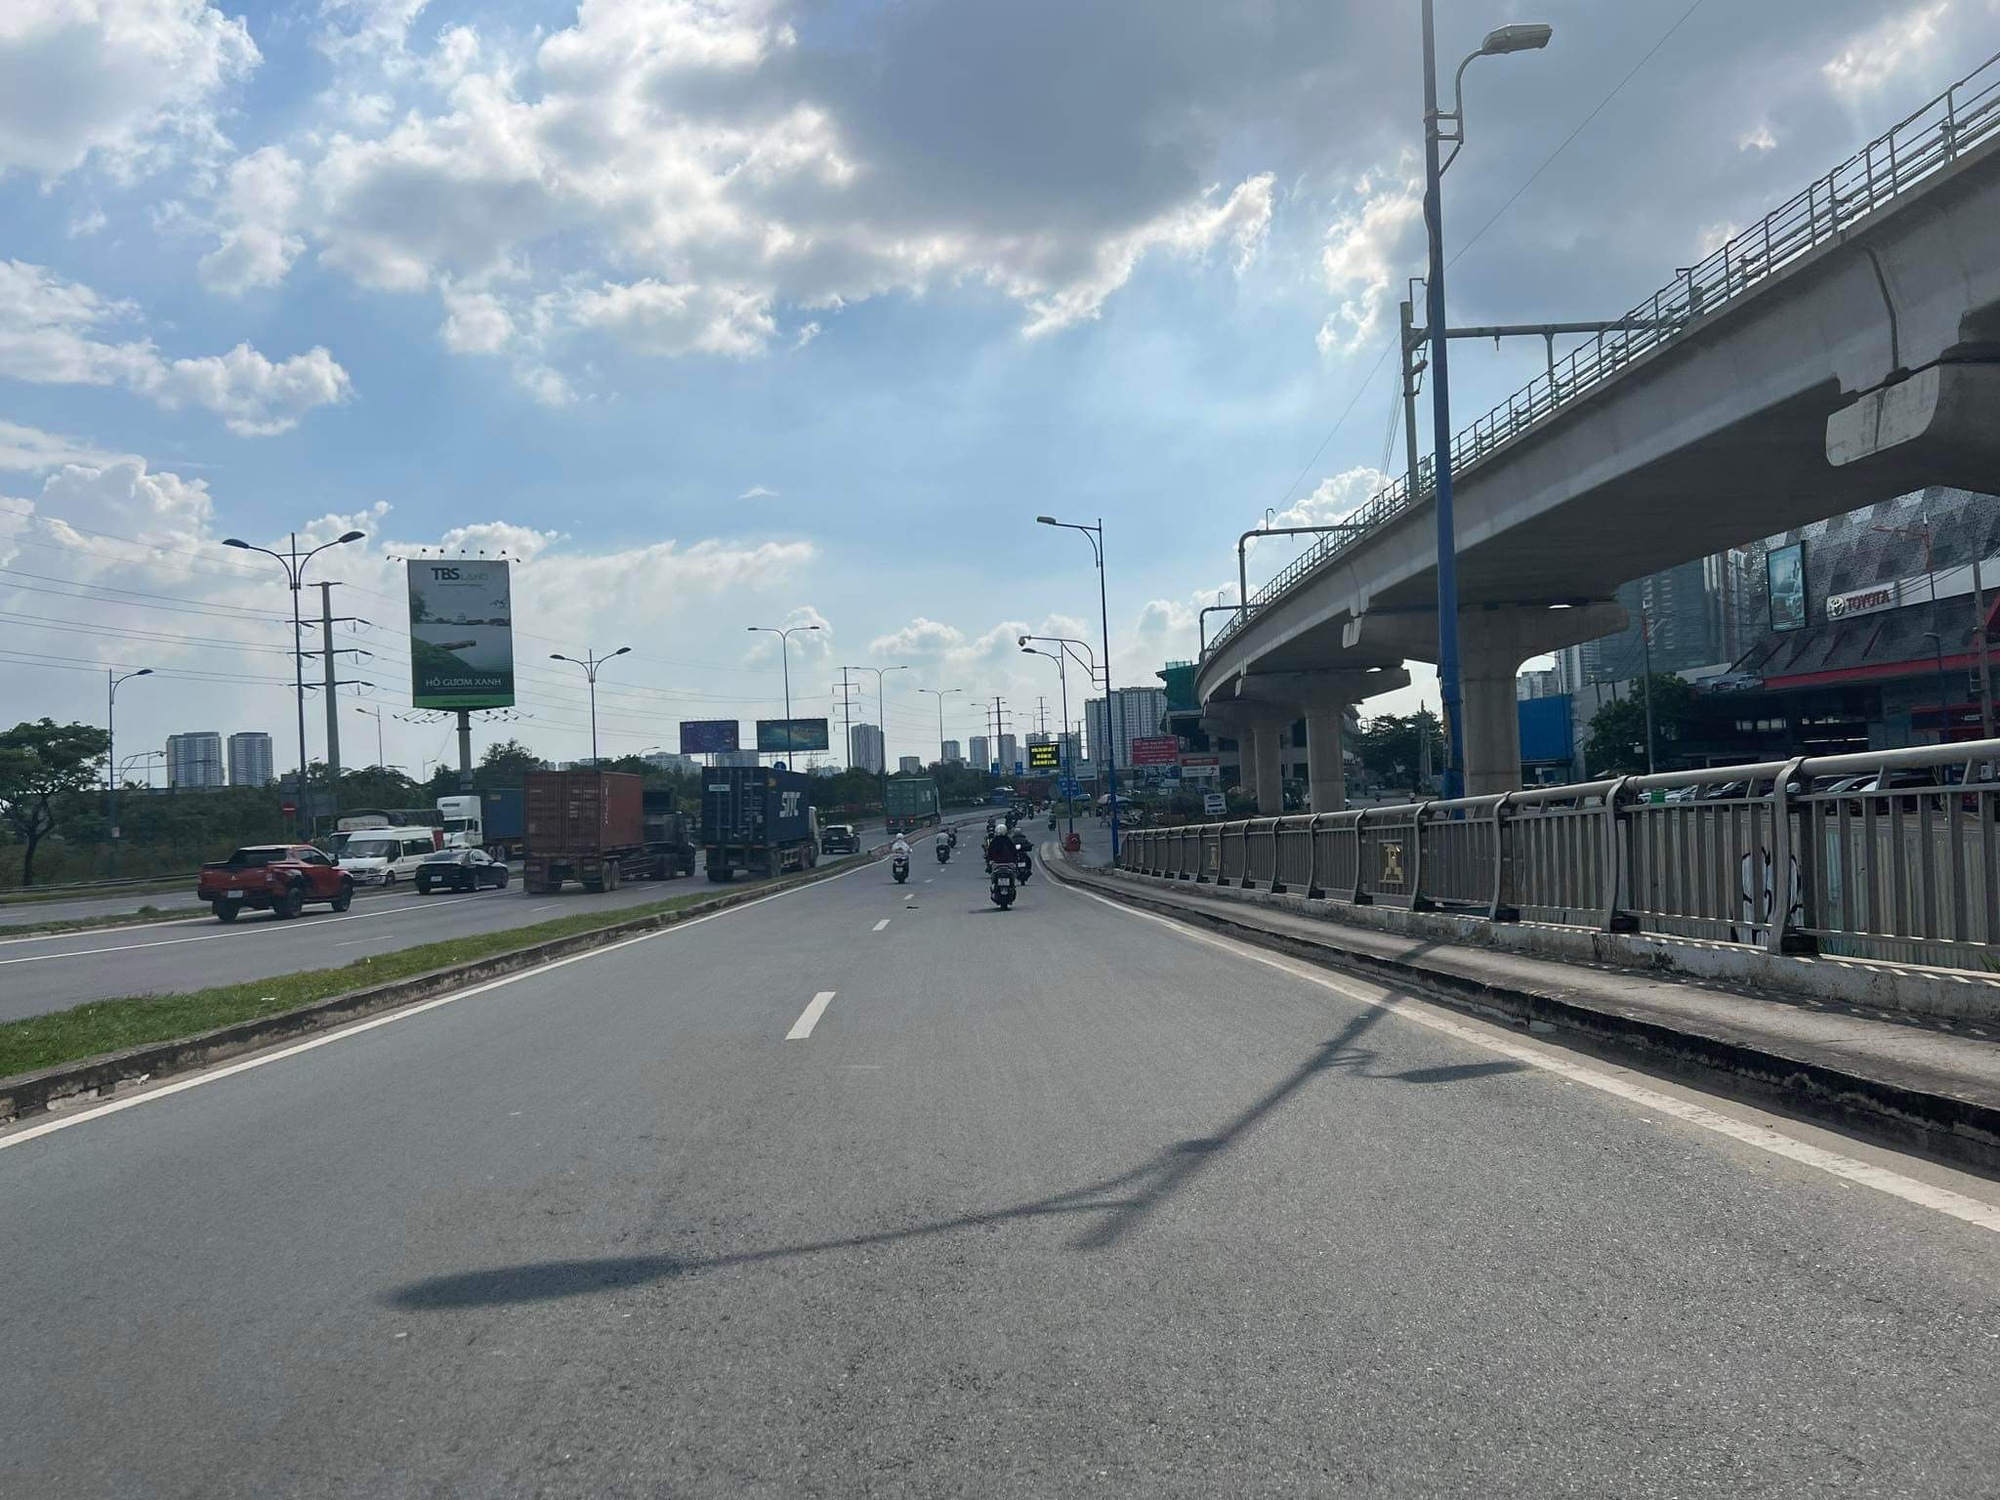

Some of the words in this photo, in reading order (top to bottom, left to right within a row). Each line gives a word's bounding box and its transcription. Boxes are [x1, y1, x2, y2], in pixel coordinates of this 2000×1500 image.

[431, 567, 460, 580] TBS
[1846, 589, 1890, 611] TOYOTA
[474, 677, 502, 687] XANH
